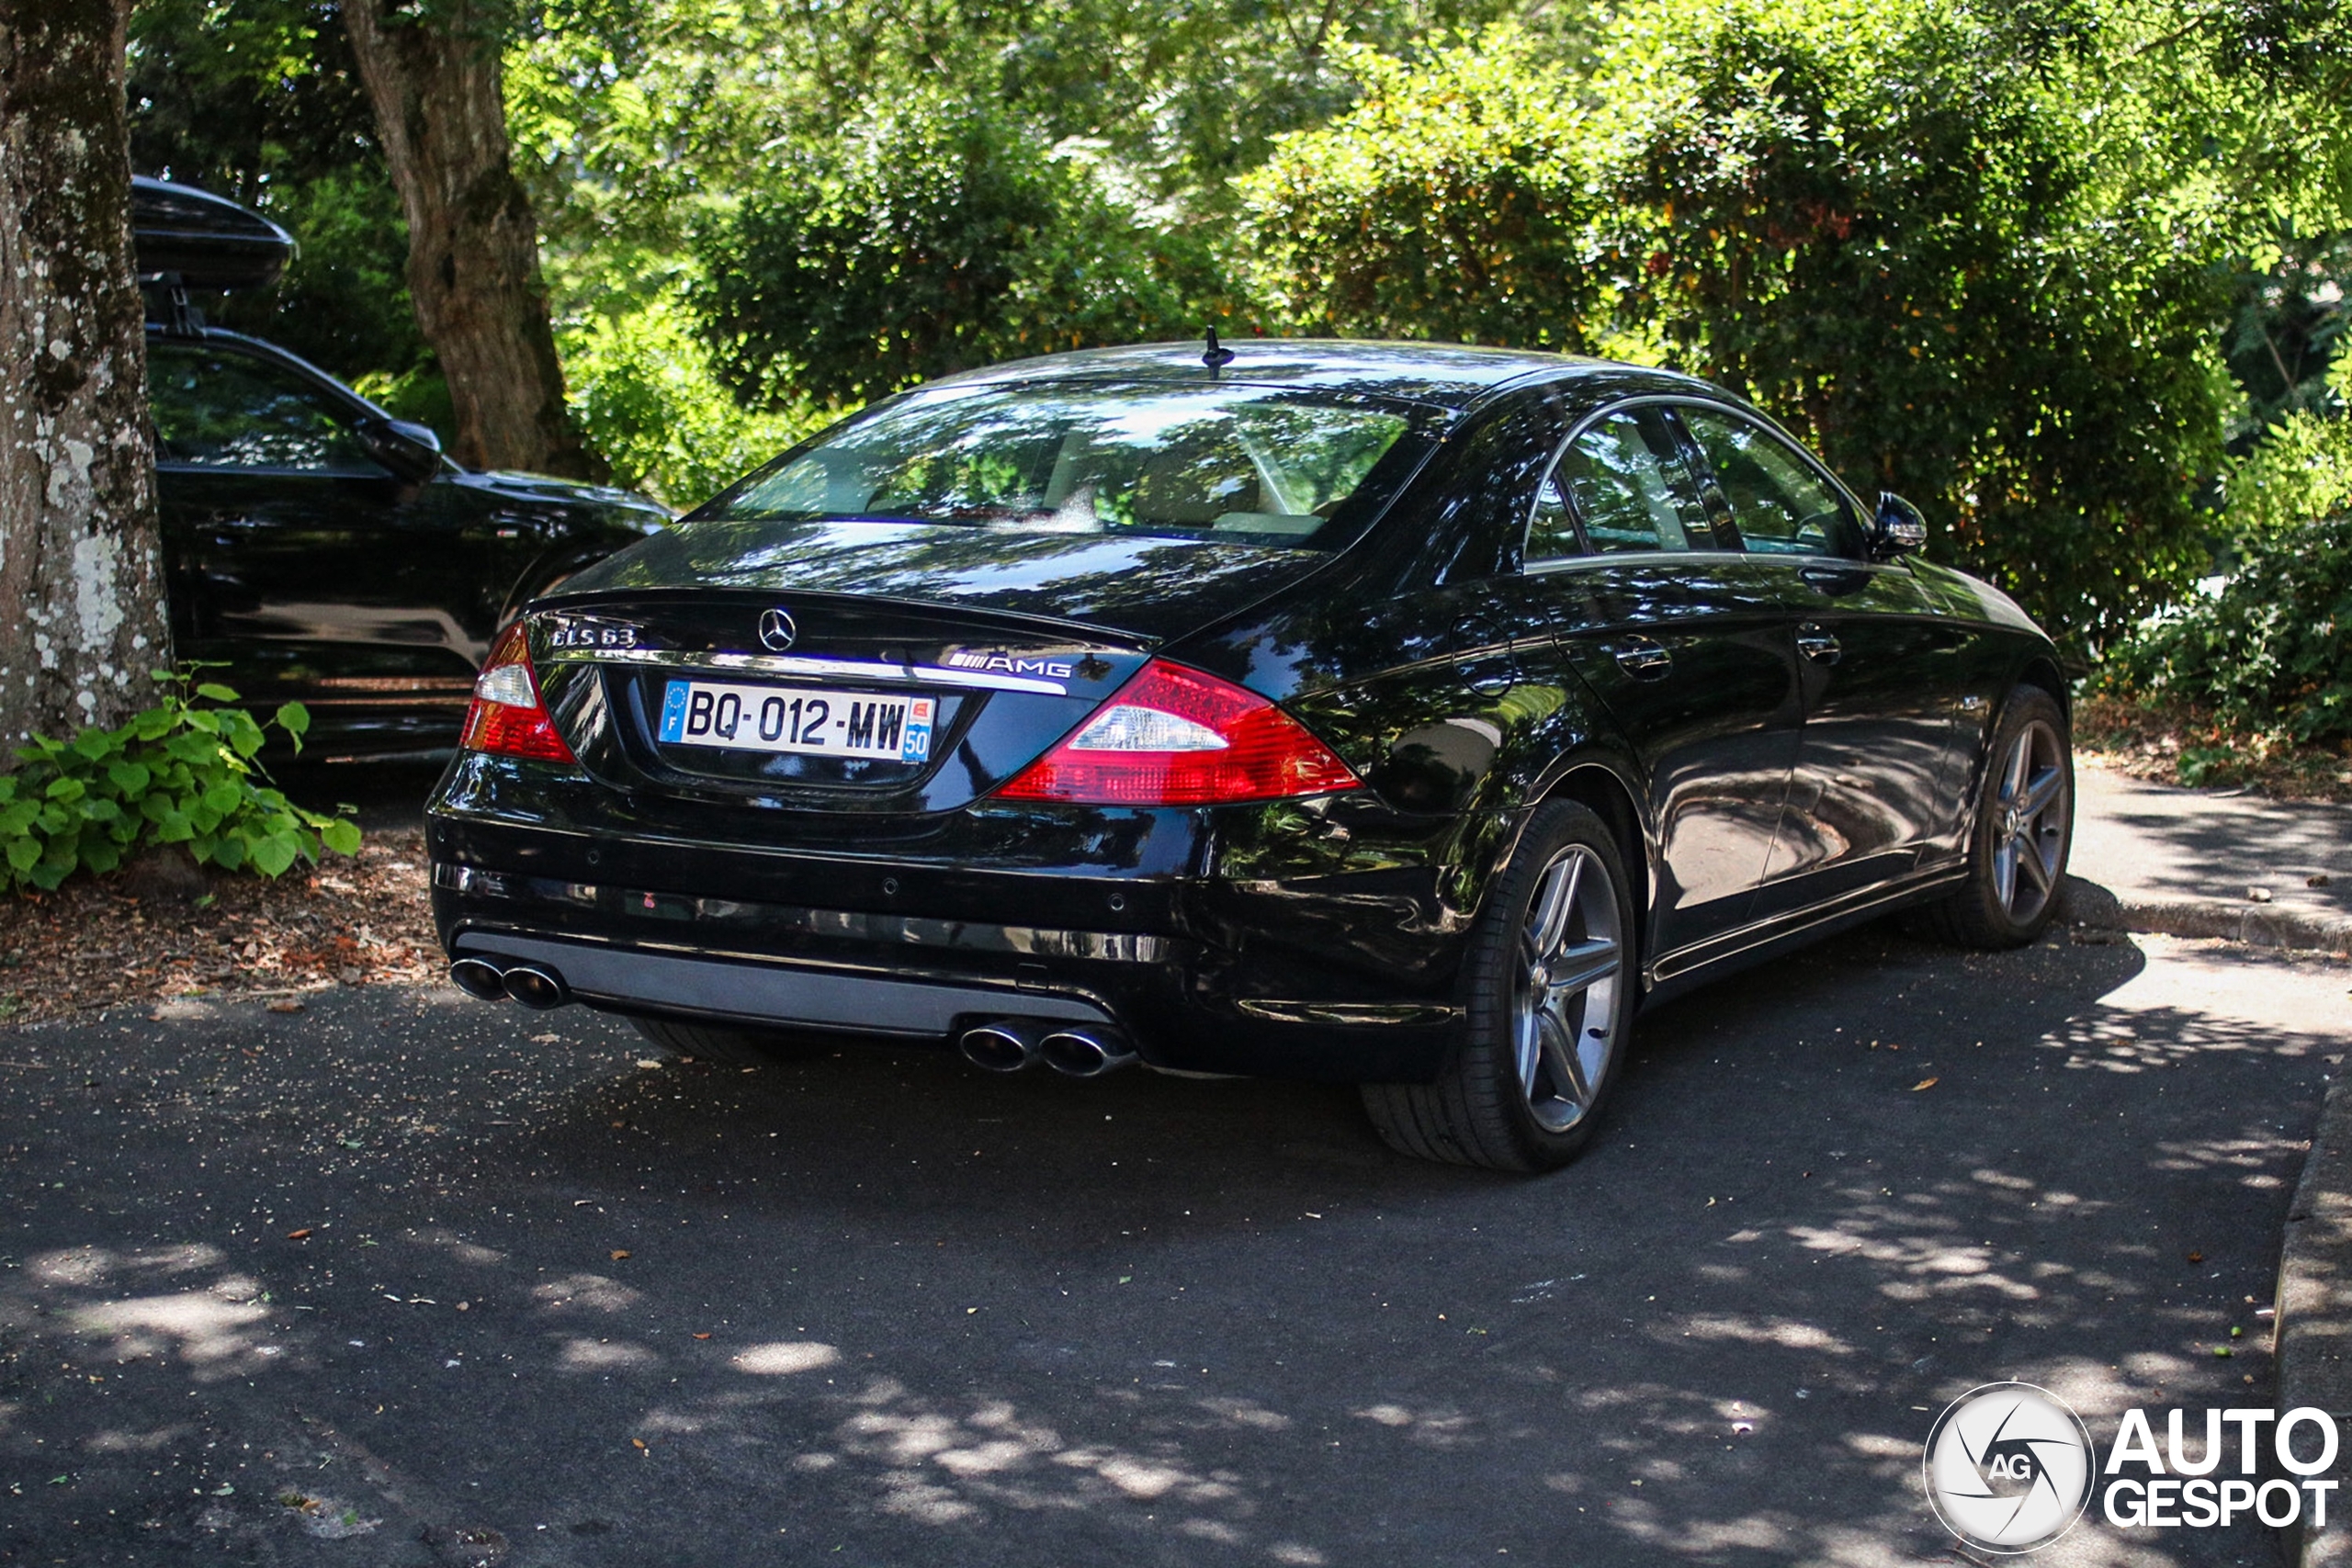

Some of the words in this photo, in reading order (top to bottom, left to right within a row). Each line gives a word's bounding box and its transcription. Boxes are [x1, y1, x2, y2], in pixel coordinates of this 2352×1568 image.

[602, 628, 636, 647] 63
[986, 656, 1072, 679] AMG
[668, 716, 677, 731] F
[686, 690, 905, 750] BQ-012-MW
[904, 730, 928, 755] 50
